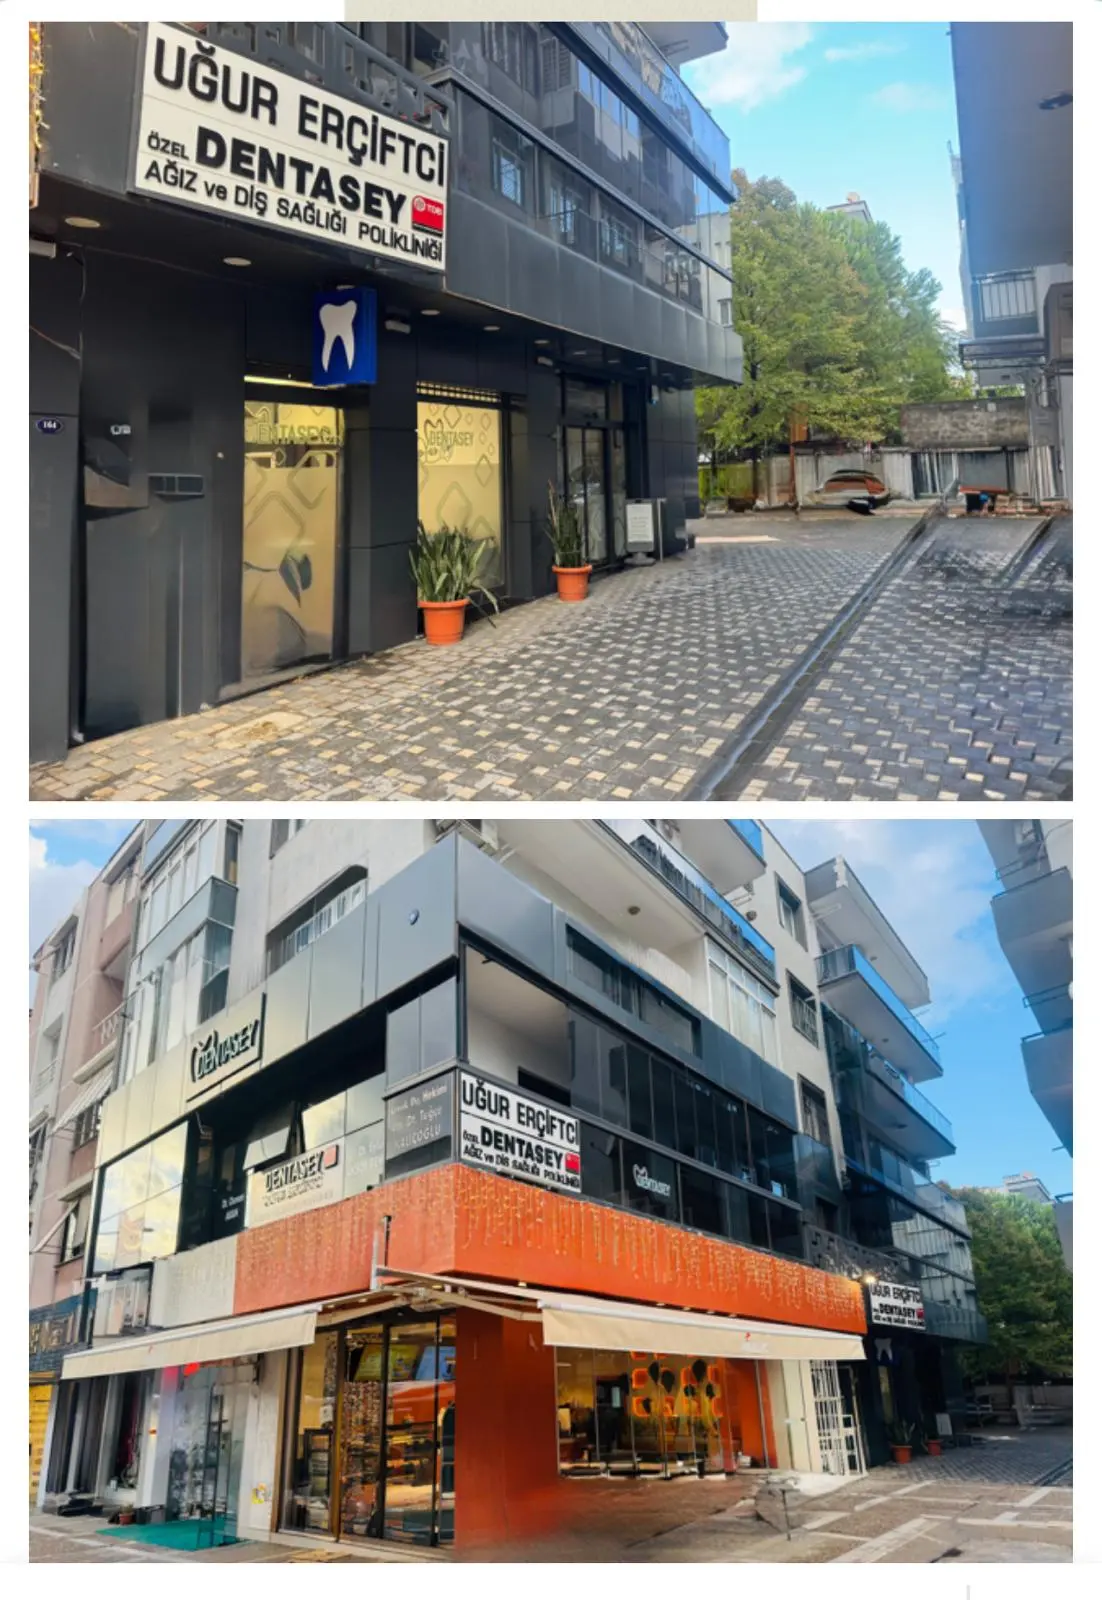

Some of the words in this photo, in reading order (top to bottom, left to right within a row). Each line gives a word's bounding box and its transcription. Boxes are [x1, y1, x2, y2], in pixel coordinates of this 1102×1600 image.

[154, 37, 278, 126] UĞUR
[298, 93, 445, 187] ERÇİFTCİ
[147, 130, 190, 161] ÖZEL
[195, 125, 407, 224] DENTASEY
[145, 159, 198, 193] AĞIZ
[204, 180, 228, 201] ve
[234, 184, 268, 218] DİŞ
[276, 197, 347, 235] SAĞLIĞI
[358, 221, 443, 262] POLİKLİNİĞİ
[198, 1020, 259, 1080] DENTASEY
[463, 1076, 510, 1120] UĞUR
[516, 1101, 580, 1145] ERÇİFTCİ
[266, 1151, 324, 1193] DENTASEY
[480, 1125, 564, 1169] DENTASEY
